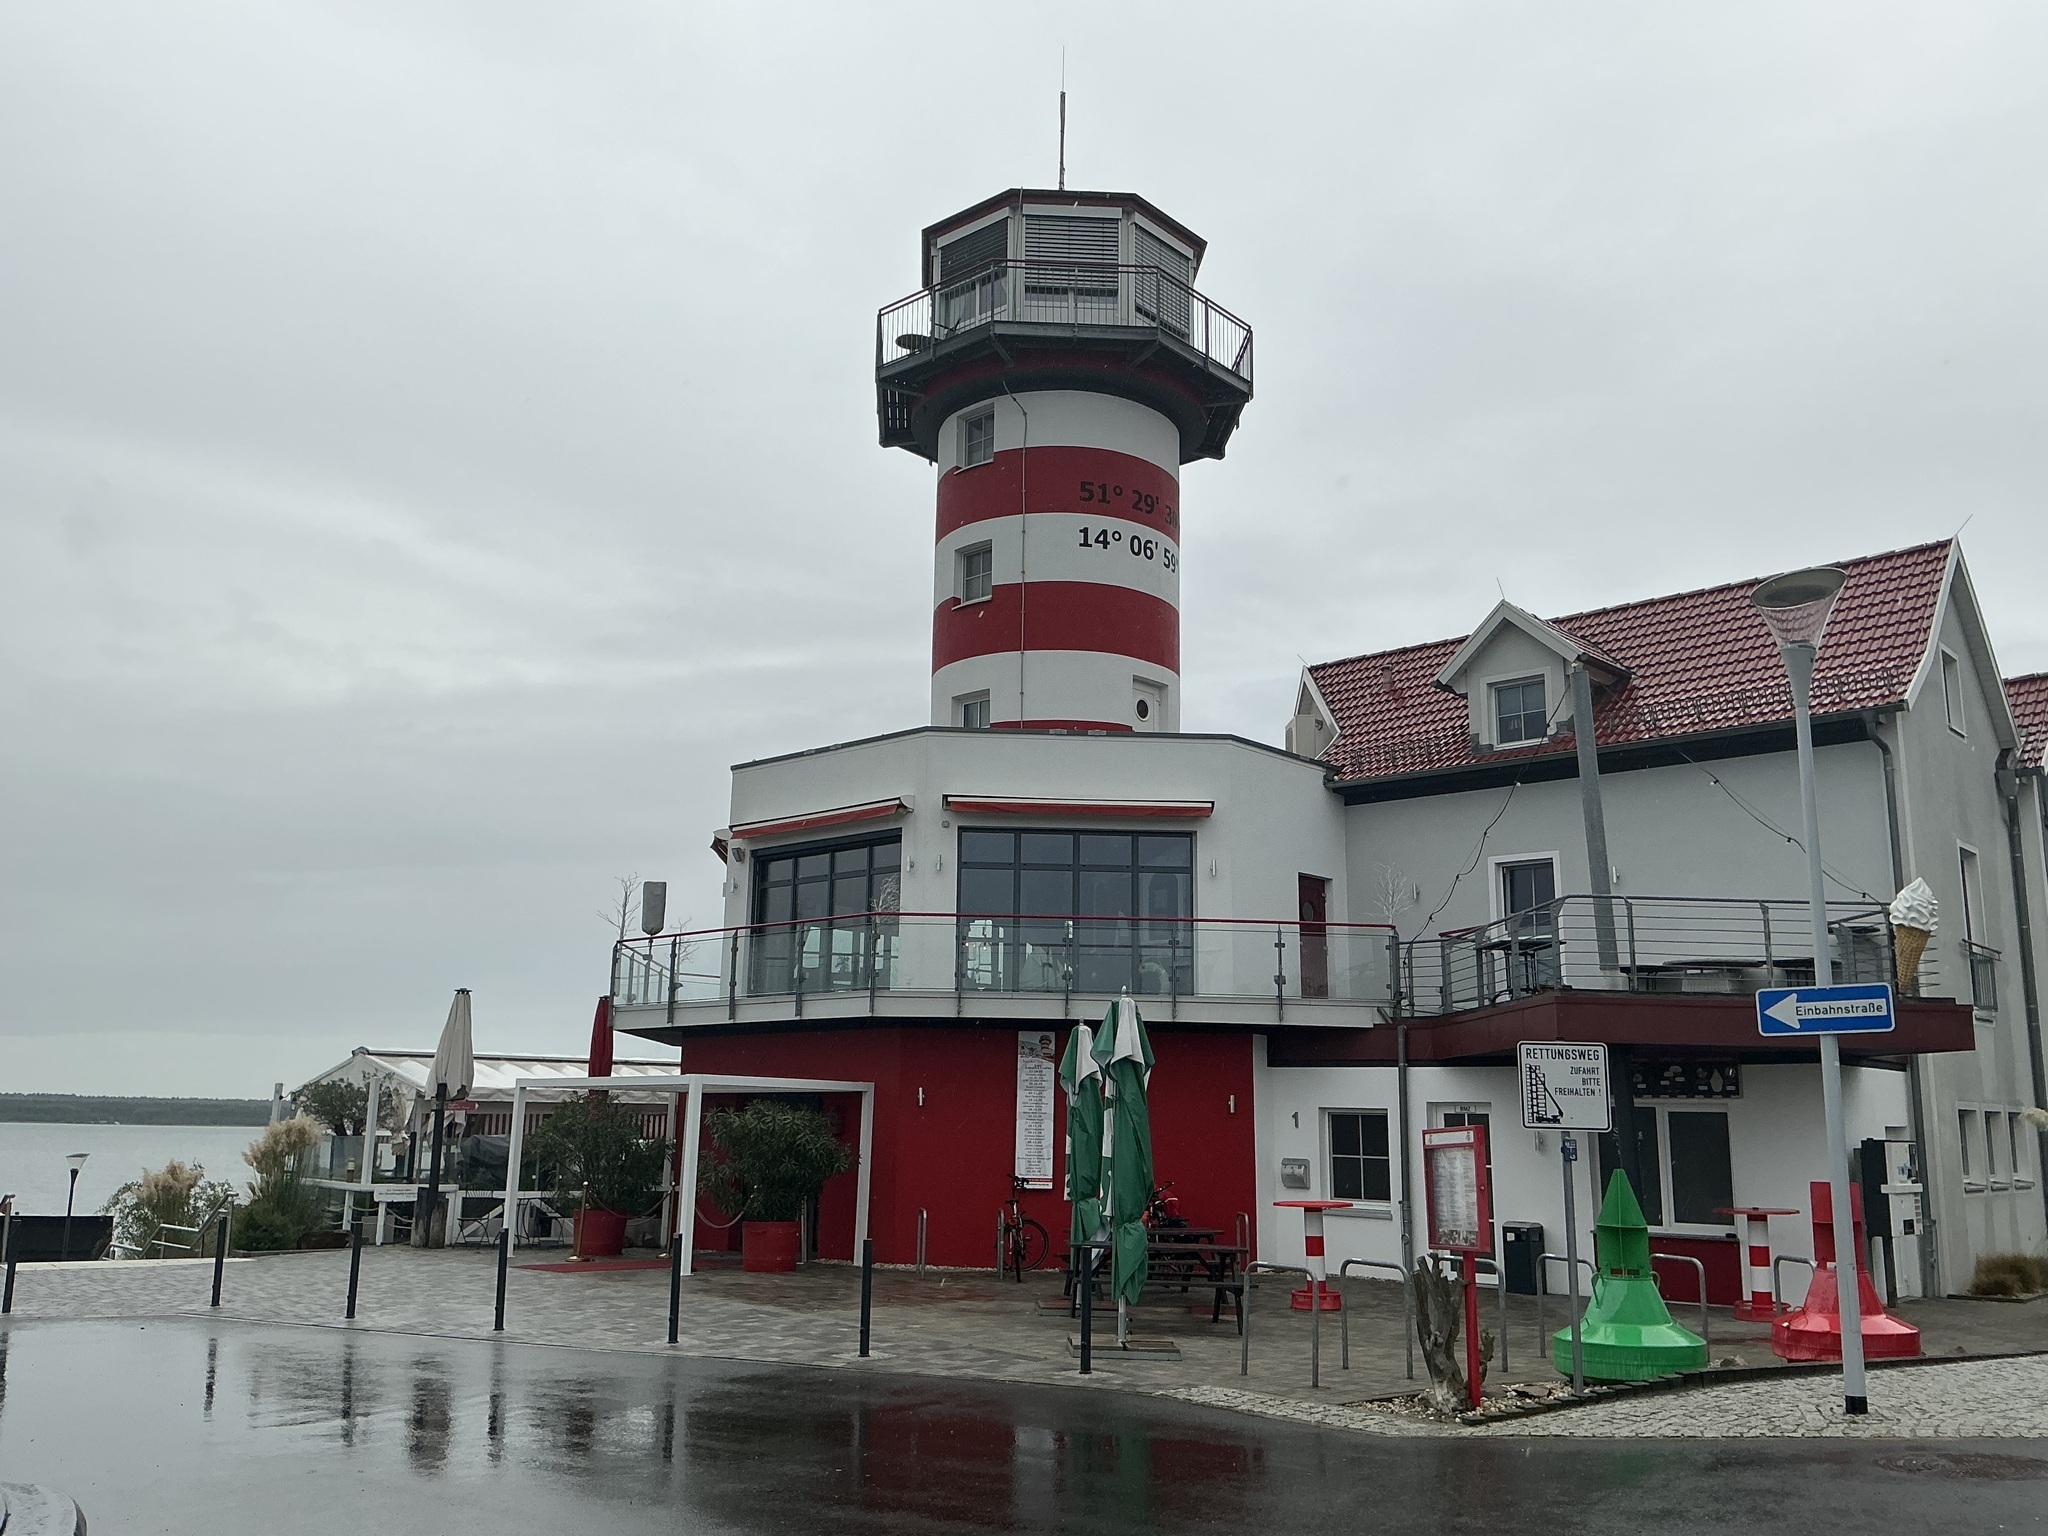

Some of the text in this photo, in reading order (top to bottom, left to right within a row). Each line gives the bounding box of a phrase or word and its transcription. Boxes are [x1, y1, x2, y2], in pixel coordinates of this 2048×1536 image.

[1079, 527, 1122, 549] 14°
[1130, 535, 1158, 560] 06'
[1796, 1002, 1883, 1016] Einbahnstraße
[1525, 1048, 1600, 1060] RETTUNGSWEG
[1570, 1066, 1600, 1075] ZUFAHRT
[1582, 1078, 1601, 1086] BITTE
[1554, 1087, 1596, 1096] FREIHALTEN
[1291, 1112, 1299, 1128] 1
